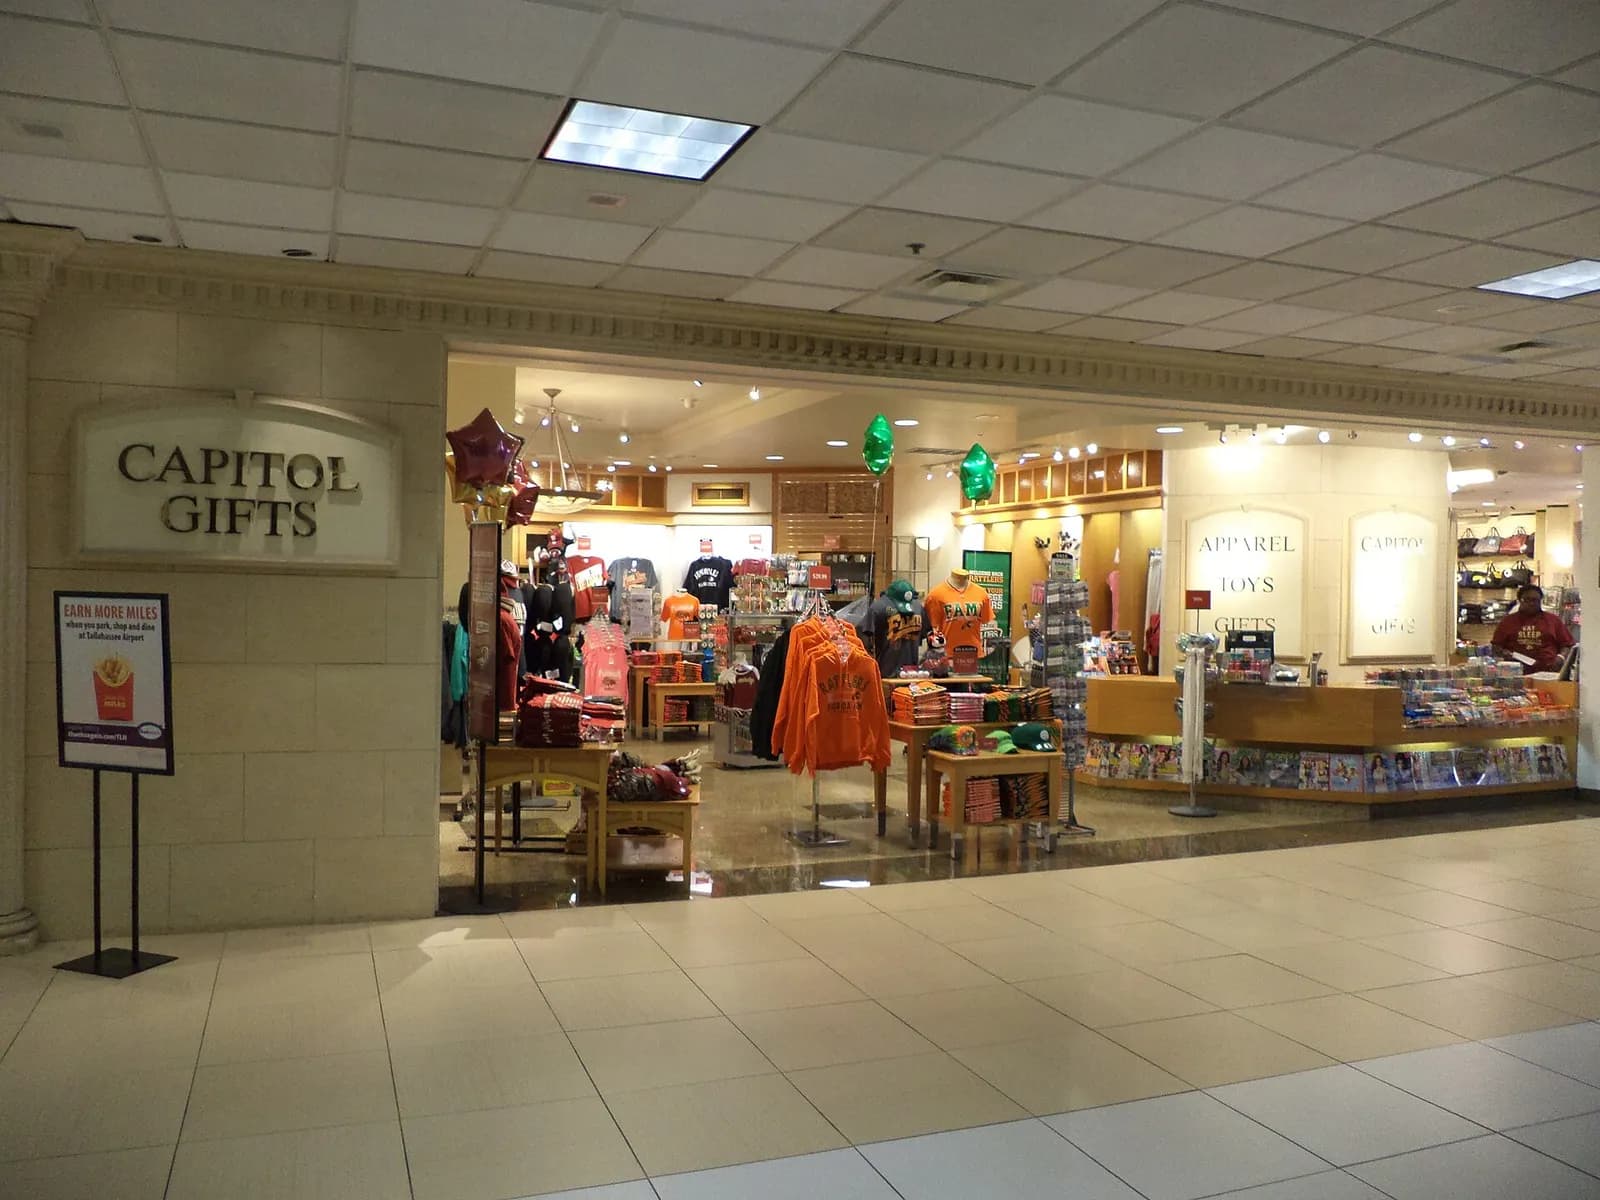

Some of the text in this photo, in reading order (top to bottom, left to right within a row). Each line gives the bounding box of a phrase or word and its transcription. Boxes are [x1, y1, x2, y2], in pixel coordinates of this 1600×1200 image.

[118, 443, 360, 493] CAPITOL
[160, 494, 318, 538] GIFTS
[1198, 535, 1296, 552] APPAREL
[1216, 575, 1275, 593] TOYS
[63, 604, 158, 620] EARN MORE MILES
[65, 621, 155, 631] when you park, shop and dine
[1214, 616, 1277, 634] GIFTS
[86, 632, 122, 641] Tallahassee
[122, 633, 144, 643] Airport
